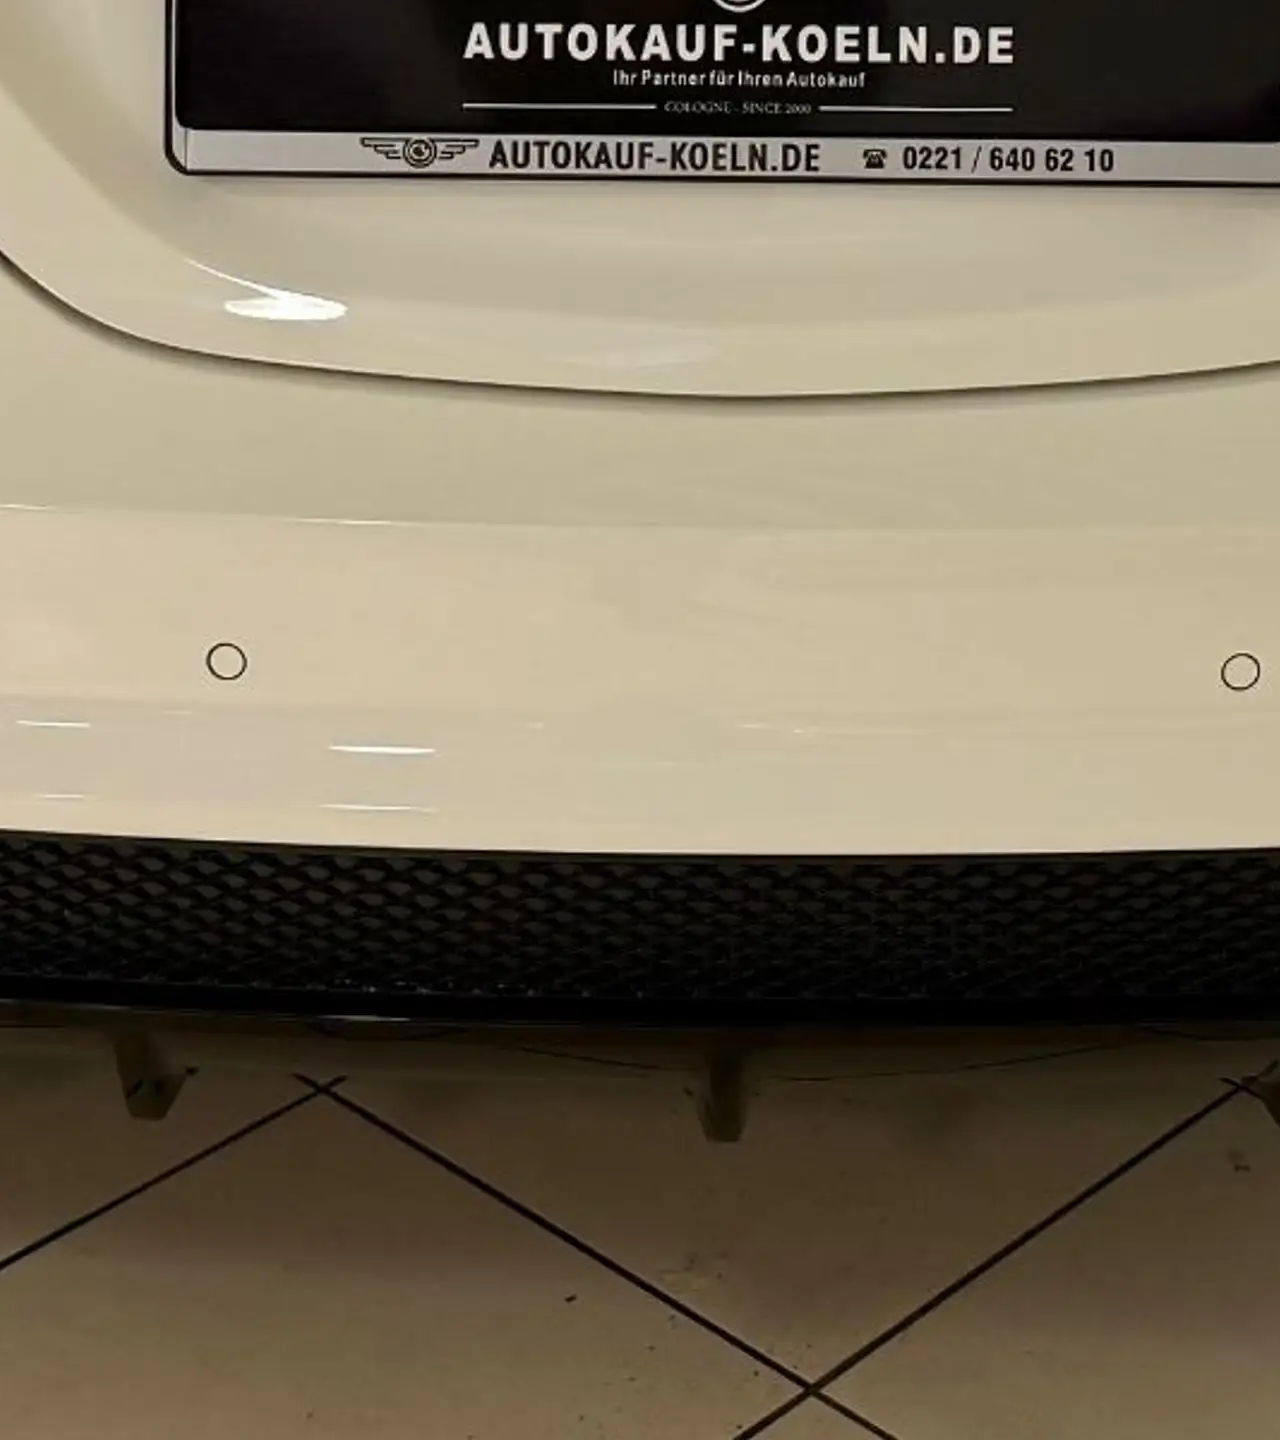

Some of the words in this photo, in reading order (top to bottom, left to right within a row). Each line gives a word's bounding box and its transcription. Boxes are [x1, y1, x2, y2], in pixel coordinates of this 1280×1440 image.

[463, 22, 1014, 64] AUTOKAUF-KOELN.DE
[613, 69, 636, 86] Ihr
[641, 69, 707, 86] Partner
[710, 69, 735, 86] für
[738, 70, 783, 87] Ihren
[786, 71, 867, 88] Autokauf
[664, 100, 732, 114] COLOGNE
[742, 101, 782, 114] SINCE
[785, 103, 812, 115] 2000
[488, 140, 821, 173] AUTOKAUF-KOELN.DE
[902, 146, 963, 171] 0221
[989, 147, 1036, 172] 640
[1045, 148, 1075, 172] 62
[1084, 148, 1115, 172] 10
